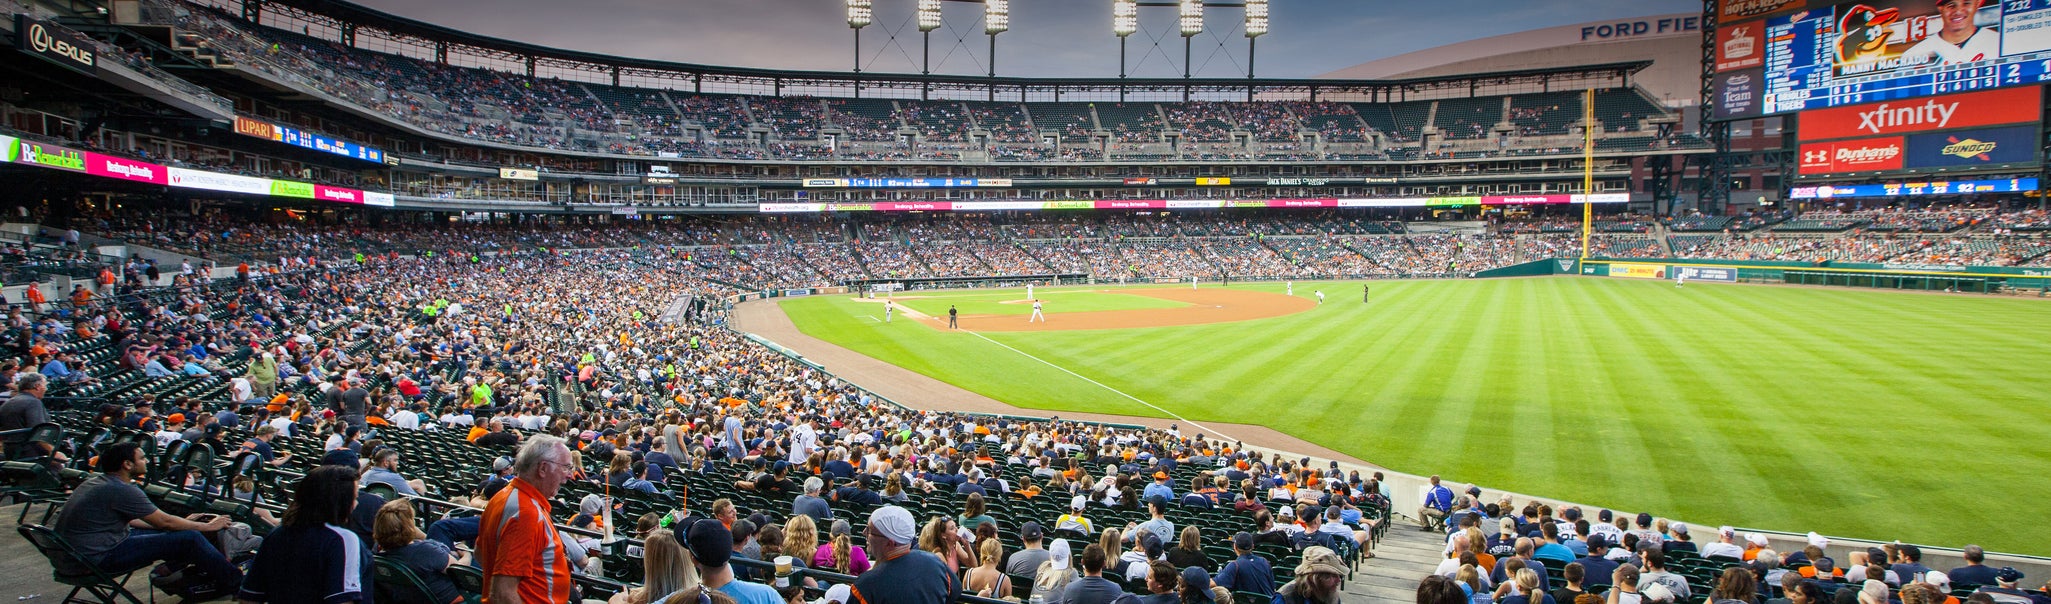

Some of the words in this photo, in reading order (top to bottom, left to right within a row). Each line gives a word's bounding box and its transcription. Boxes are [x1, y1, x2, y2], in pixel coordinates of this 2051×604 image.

[1581, 21, 1649, 40] FORD
[1905, 15, 1928, 42] 13
[48, 36, 93, 66] LEXUS
[1842, 61, 1877, 75] MANNY
[1878, 55, 1929, 70] MACHADO
[2007, 64, 2021, 77] 2
[1777, 89, 1811, 101] ORIOLES
[1939, 72, 1947, 82] 7
[1985, 67, 1993, 76] 3
[1723, 91, 1751, 102] Team
[1858, 99, 1960, 133] xfinity
[240, 119, 270, 137] LIPARI
[1944, 143, 1993, 154] SUNOCO
[1267, 177, 1280, 185] JACK
[1280, 177, 1302, 185] DANIEL'S
[1957, 183, 1974, 192] 92
